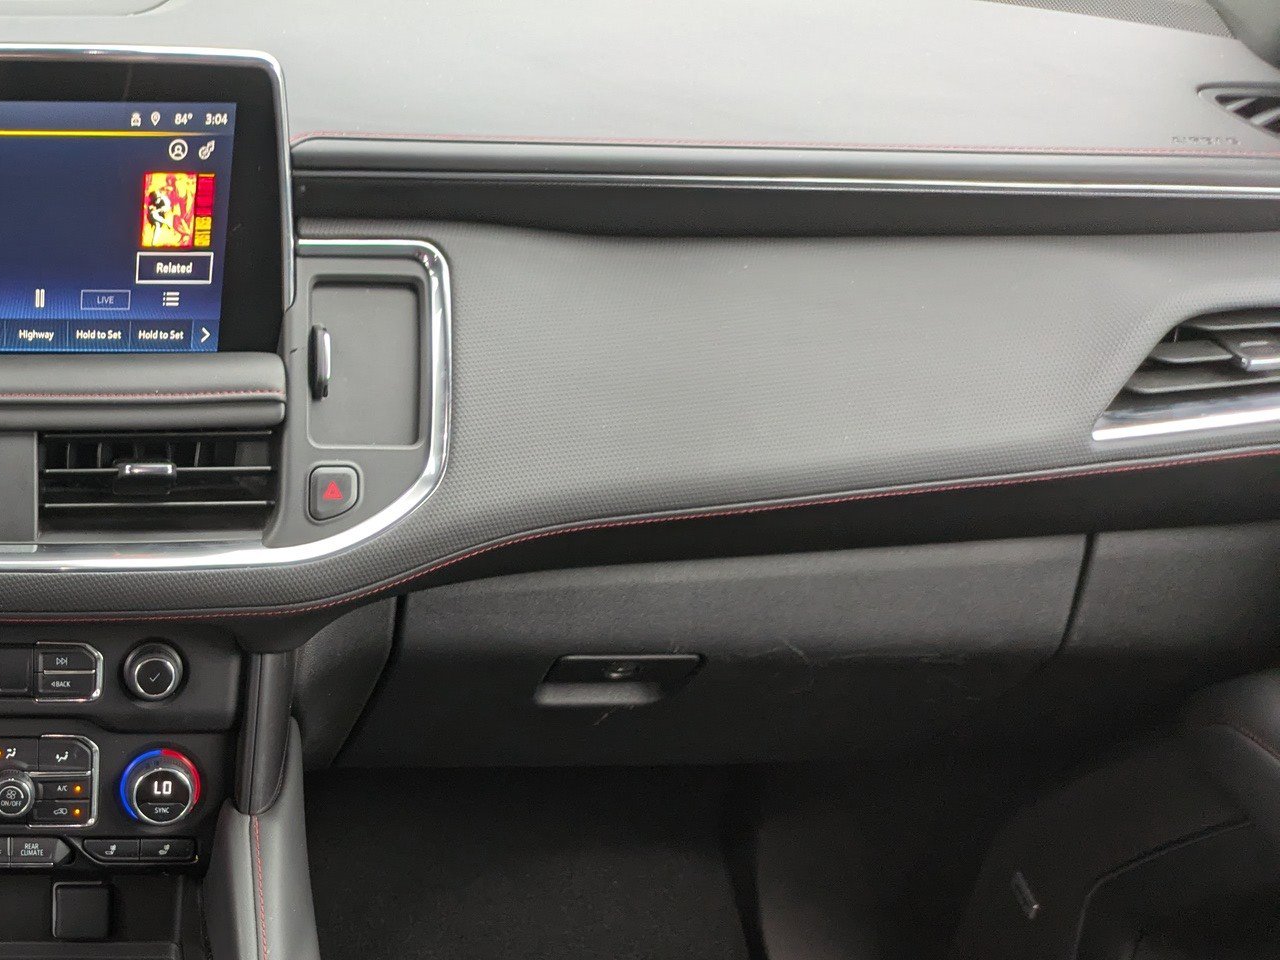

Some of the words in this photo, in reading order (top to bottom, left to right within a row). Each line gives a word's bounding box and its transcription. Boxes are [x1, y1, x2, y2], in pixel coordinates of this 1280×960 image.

[205, 112, 228, 125] 3:04
[156, 262, 193, 274] Related
[96, 295, 115, 305] LIVE
[18, 329, 54, 342] Highway
[76, 329, 96, 340] Hold
[97, 330, 106, 340] to
[107, 329, 122, 340] Set
[138, 329, 158, 340] Hold
[159, 330, 168, 340] to
[169, 329, 184, 340] Set
[55, 680, 71, 688] BACK
[153, 780, 172, 795] LO
